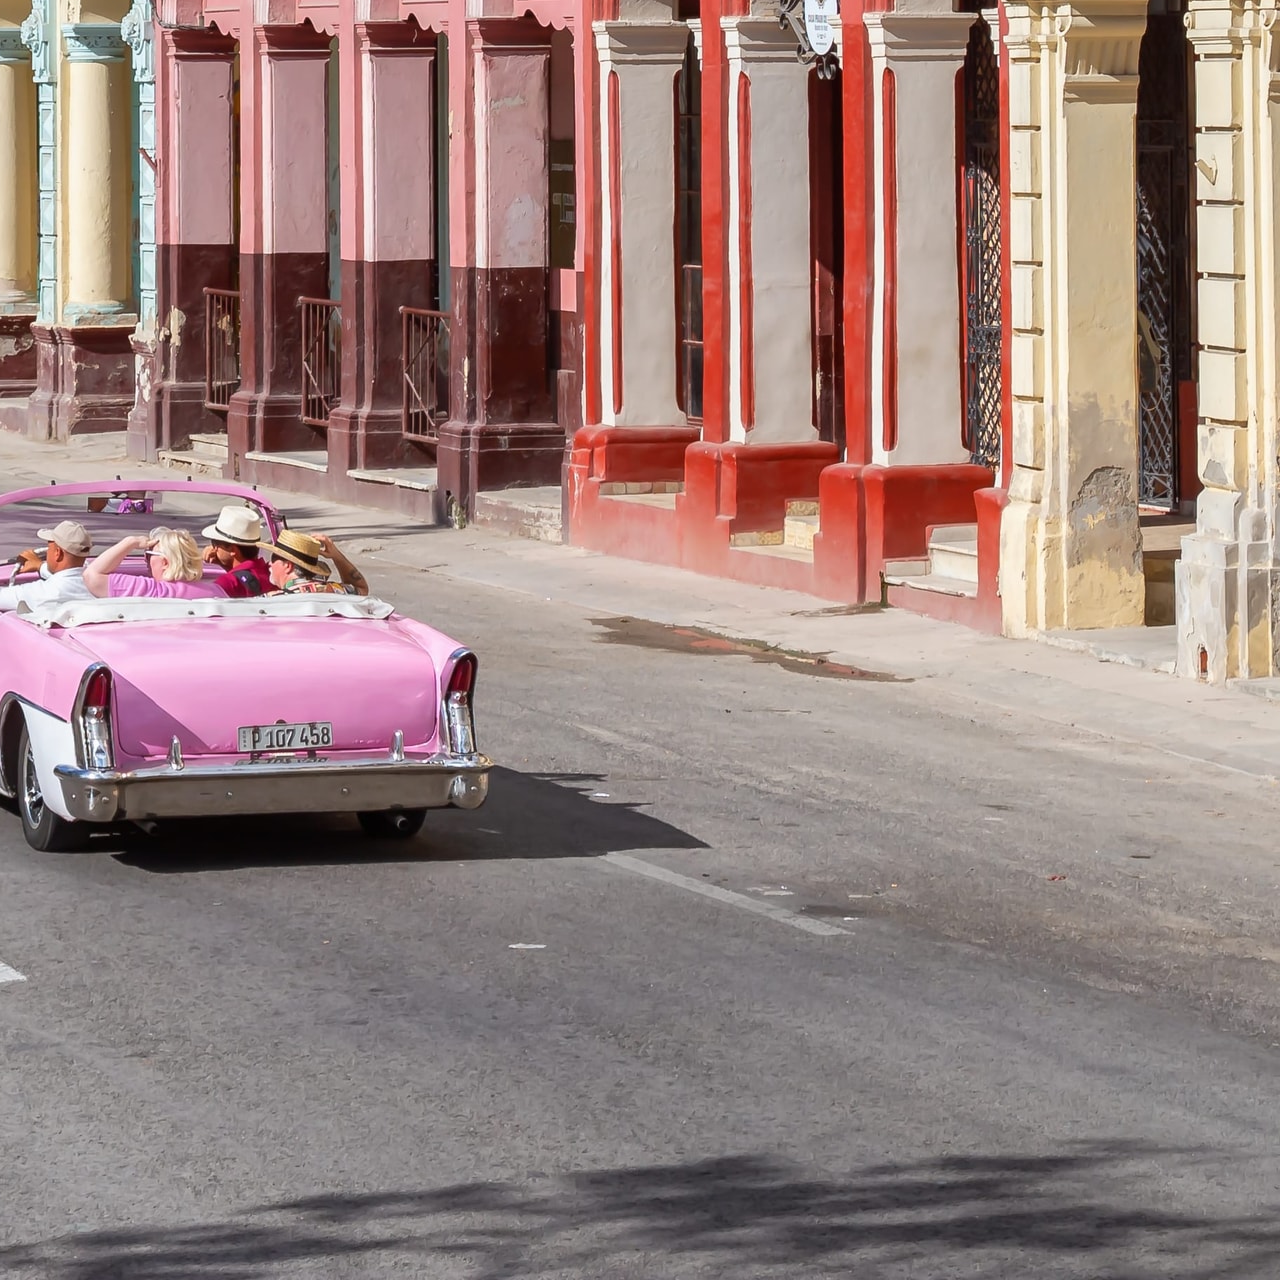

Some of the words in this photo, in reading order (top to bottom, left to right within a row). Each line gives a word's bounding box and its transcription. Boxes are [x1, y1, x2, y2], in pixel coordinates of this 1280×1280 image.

[251, 728, 261, 750] P
[265, 728, 296, 749] 107
[300, 726, 331, 746] 458
